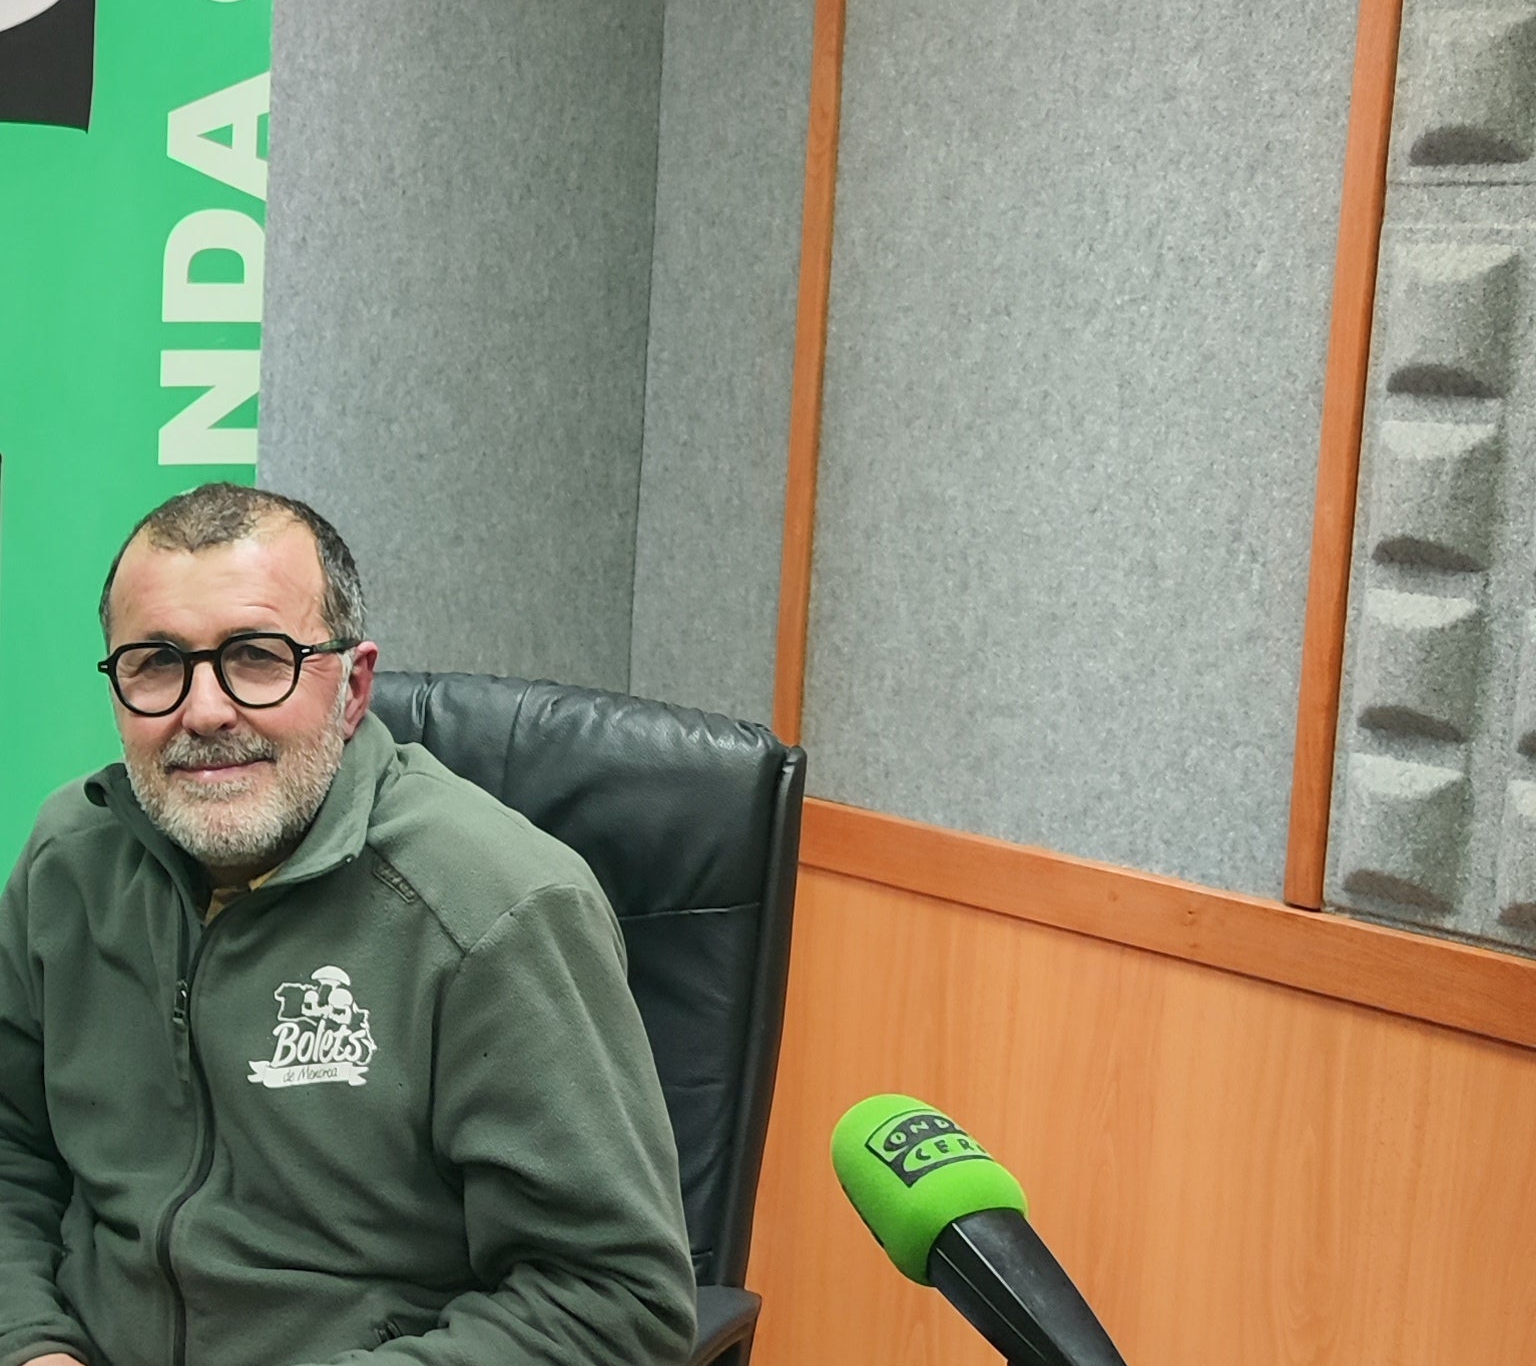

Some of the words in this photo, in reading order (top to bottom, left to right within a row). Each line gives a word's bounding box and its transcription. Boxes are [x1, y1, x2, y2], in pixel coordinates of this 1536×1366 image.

[158, 71, 270, 467] NDA
[271, 1019, 366, 1068] Bolets
[890, 1118, 962, 1145] OND
[915, 1138, 986, 1161] CER
